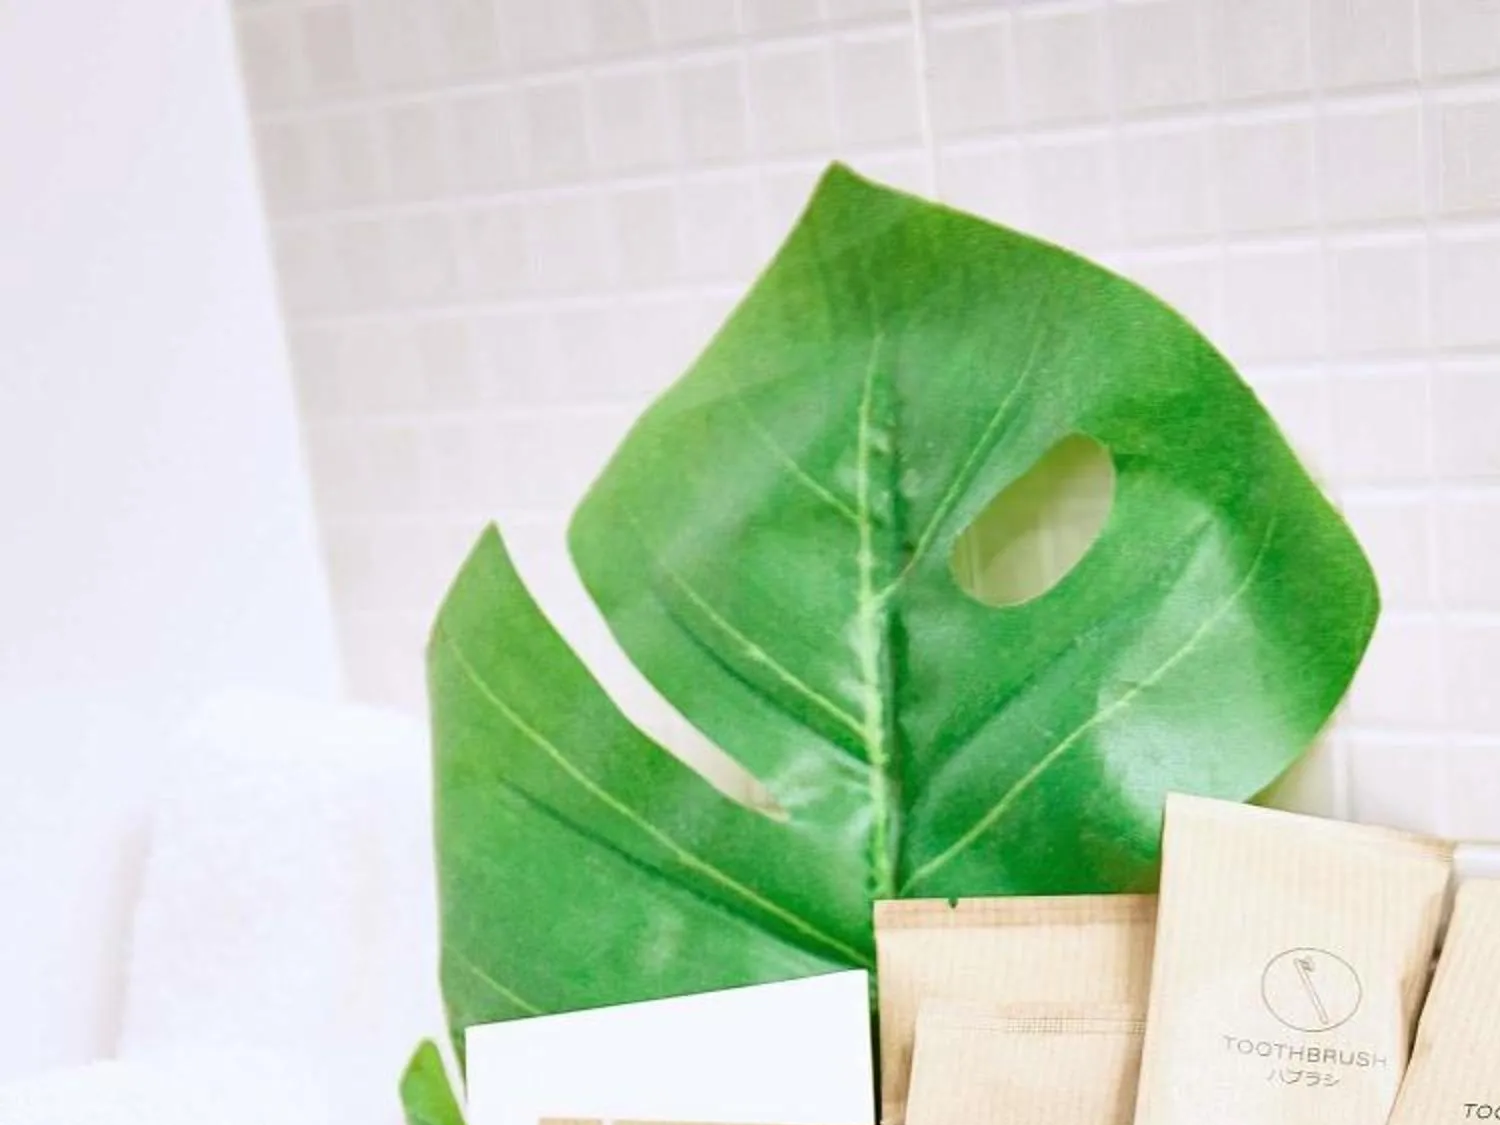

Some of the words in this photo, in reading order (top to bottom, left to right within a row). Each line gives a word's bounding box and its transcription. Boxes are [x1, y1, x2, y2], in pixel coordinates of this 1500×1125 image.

[1223, 1034, 1388, 1069] TOOTHBRUSH
[1266, 1068, 1340, 1087] ハブラシ
